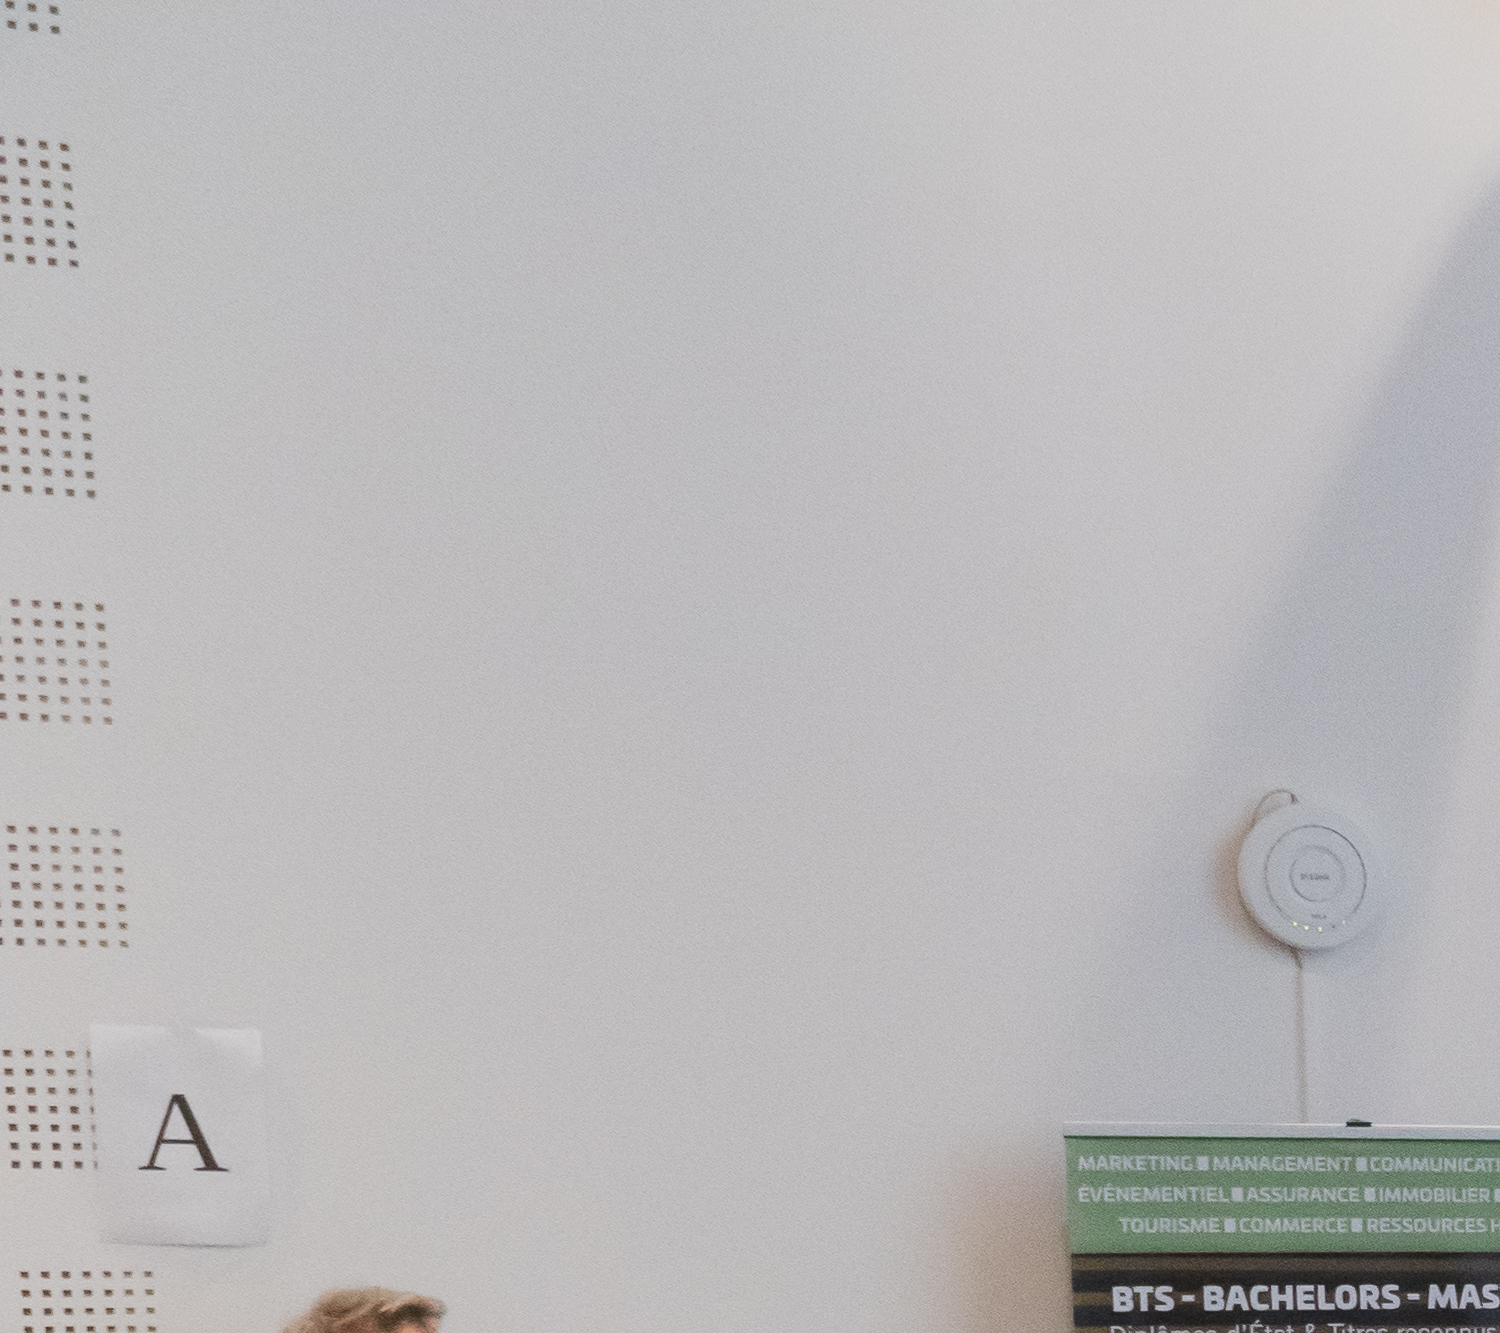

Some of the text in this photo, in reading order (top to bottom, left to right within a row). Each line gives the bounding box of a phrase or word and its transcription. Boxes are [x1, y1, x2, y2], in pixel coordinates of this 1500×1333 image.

[138, 1094, 229, 1172] A
[1078, 1155, 1193, 1171] MARKETING
[1213, 1156, 1351, 1172] MANAGEMENT
[1078, 1184, 1230, 1203] ÉVÉNEMENTIEL
[1247, 1187, 1359, 1202] ASSURANCE
[1379, 1187, 1491, 1203] IMMOBILIER
[1119, 1217, 1221, 1234] TOURISME
[1239, 1217, 1349, 1234] COMMERCE
[1367, 1218, 1487, 1234] RESSOURCES
[1112, 1285, 1175, 1312] BTS
[1203, 1284, 1400, 1312] BACHELORS
